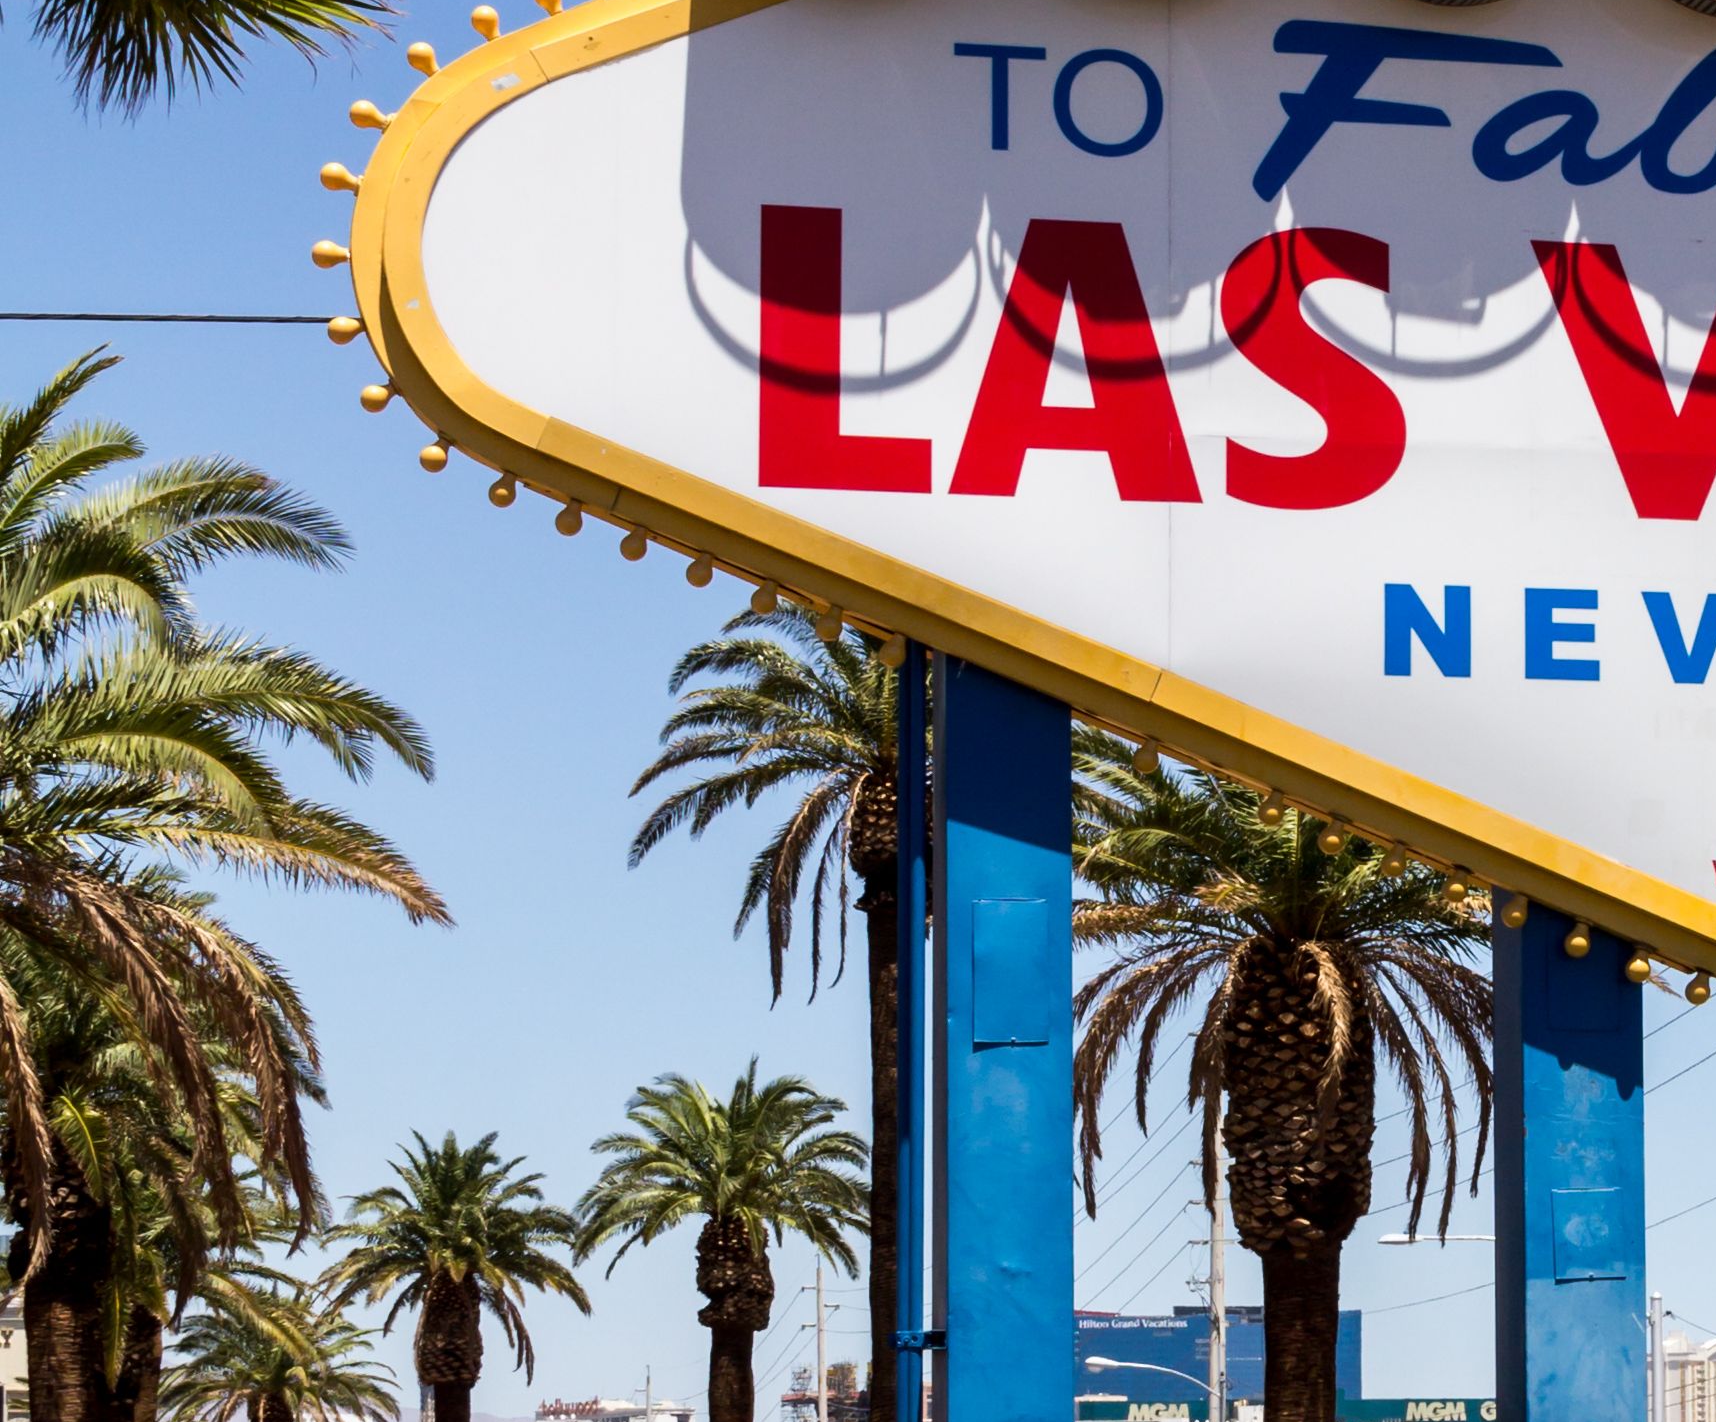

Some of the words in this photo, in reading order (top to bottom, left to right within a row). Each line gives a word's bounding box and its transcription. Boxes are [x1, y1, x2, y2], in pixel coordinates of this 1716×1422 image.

[954, 43, 1163, 158] TO
[759, 205, 1406, 509] LAS
[1079, 1319, 1109, 1329] Hilton
[1111, 1319, 1141, 1328] Grand
[1142, 1319, 1188, 1328] Vacations
[1128, 1403, 1190, 1421] MGM
[1406, 1401, 1467, 1422] MGM
